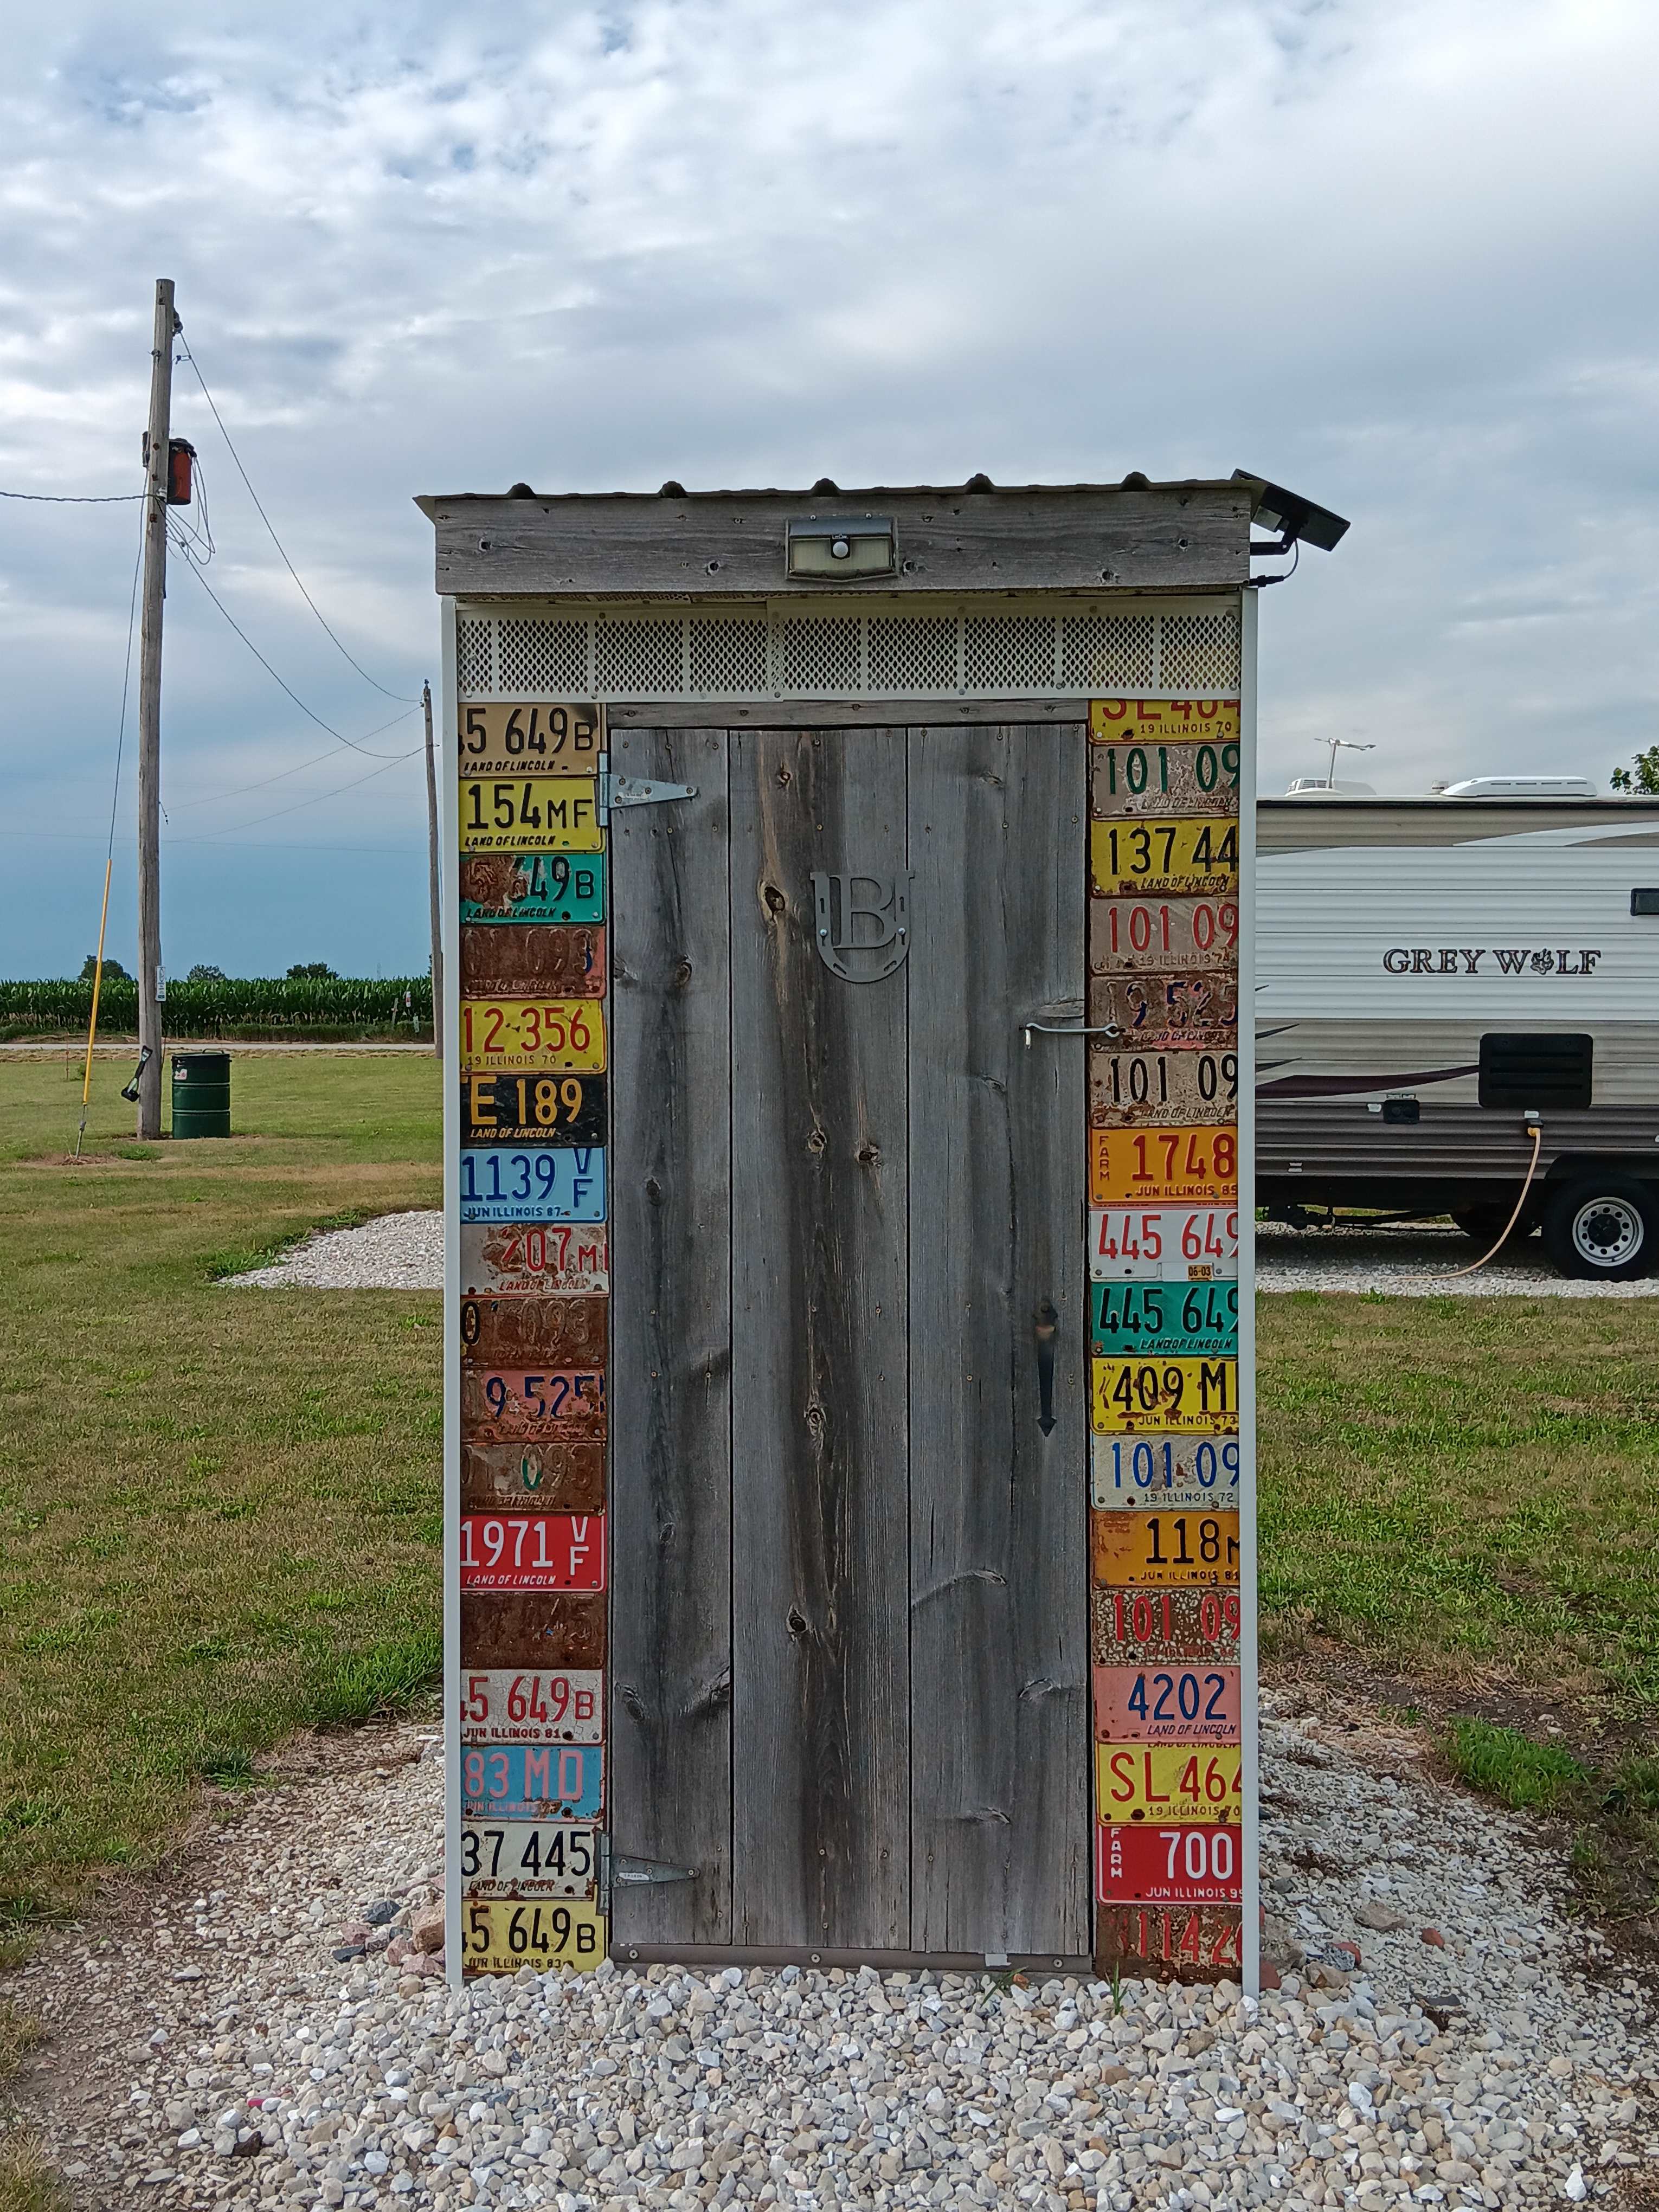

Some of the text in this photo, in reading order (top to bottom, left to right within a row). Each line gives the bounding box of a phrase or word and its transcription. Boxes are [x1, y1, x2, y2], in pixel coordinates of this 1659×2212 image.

[1141, 721, 1232, 733] 19 ILLINOIS 70
[465, 760, 555, 772] LAND OF LINCOLN
[1108, 744, 1240, 794] 101 09
[465, 835, 556, 846] LAND OF LINCOLN
[1109, 825, 1239, 875] 137 44
[1141, 874, 1229, 888] LAND OF LINCOLN
[829, 874, 896, 949] B
[1109, 904, 1238, 953] 101 09
[1383, 948, 1486, 974] GREY
[464, 1007, 590, 1053] 12 356
[467, 1055, 556, 1065] 19 ILLINOIS 70
[1111, 1054, 1238, 1102] 101 09
[460, 1076, 582, 1125] E 189
[470, 1128, 556, 1138] LAND OF LINCOLN
[461, 1154, 556, 1201] 1139
[1099, 1136, 1110, 1181] FARM
[1132, 1134, 1234, 1180] 1748
[464, 1207, 561, 1218] JUN ILLINOIS 87
[1136, 1186, 1159, 1197] JUN
[1165, 1185, 1214, 1196] ILLINOIS
[1099, 1214, 1162, 1259] 445
[1099, 1288, 1163, 1334] 445
[1141, 1338, 1232, 1349] LAND OF LINCOLN
[1113, 1362, 1239, 1411] 409 M
[1139, 1416, 1237, 1425] JUN ILLINOIS 73
[1112, 1442, 1239, 1488] 101 09
[1144, 1493, 1233, 1502] 19 ILLINOIS 72
[460, 1521, 553, 1567] 1971
[467, 1574, 556, 1585] LAND OF LINCOLN
[1141, 1571, 1162, 1580] JUN
[1169, 1571, 1218, 1580] ILLINOIS
[1114, 1594, 1240, 1642] 101 09
[1128, 1673, 1226, 1720] 4202
[464, 1728, 560, 1738] JUN ILLINOIS 81
[1147, 1724, 1236, 1735] LAND OF LINCOLN
[464, 1750, 583, 1800] 83 MD
[1111, 1752, 1170, 1802] SL
[1149, 1806, 1163, 1816] 19
[1169, 1806, 1218, 1816] ILLINOIS
[461, 1830, 590, 1877] 37 445
[1111, 1828, 1122, 1878] FARM
[1160, 1832, 1232, 1880] 700
[468, 1880, 496, 1891] LAND
[497, 1881, 511, 1891] OF
[1146, 1887, 1170, 1898] JUN
[1175, 1888, 1225, 1898] ILLINOIS
[493, 1957, 542, 1968] ILLINOIS
